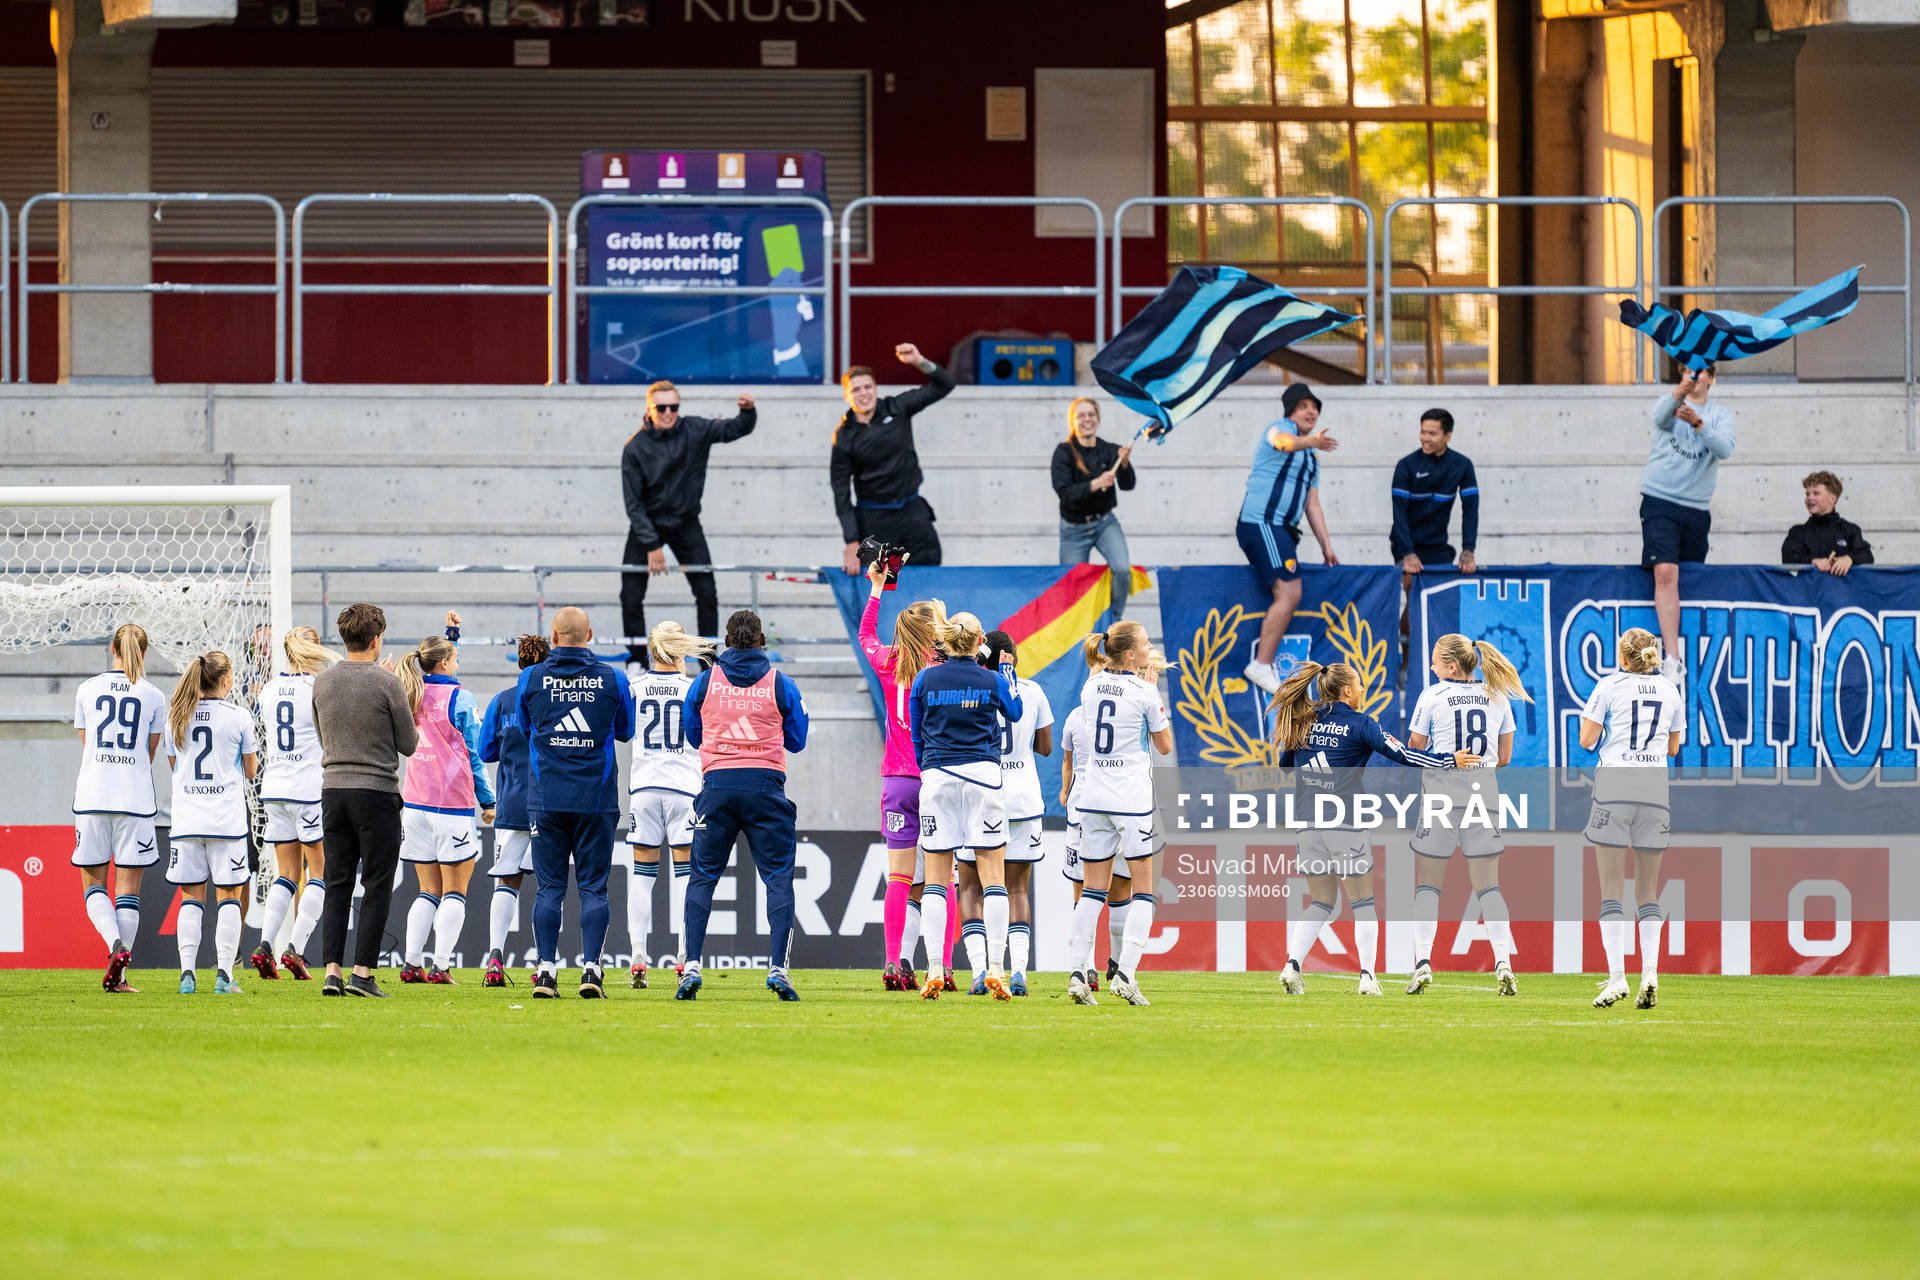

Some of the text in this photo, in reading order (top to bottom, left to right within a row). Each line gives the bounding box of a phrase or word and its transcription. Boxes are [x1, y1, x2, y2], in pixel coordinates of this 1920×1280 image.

[606, 231, 743, 250] Grönt kort för
[606, 253, 740, 275] sopsortering!
[110, 682, 131, 692] PLAN
[542, 676, 604, 690] Prioritet
[645, 685, 679, 696] LÖVGREN
[711, 682, 773, 699] Prioritet
[1096, 684, 1124, 697] KARLSEN
[1638, 685, 1657, 695] LILJA
[550, 689, 596, 702] Finans
[1447, 695, 1490, 707] BERGSTRÖM
[719, 696, 763, 711] Finans
[961, 699, 979, 708] 1891
[95, 695, 142, 750] 29
[195, 711, 211, 721] HED
[276, 700, 295, 752] 8
[640, 699, 685, 750] 20
[1094, 700, 1116, 755] 6
[1629, 700, 1663, 751] 17
[1454, 709, 1488, 757] 18
[549, 736, 594, 748] stadium
[192, 725, 214, 780] 2
